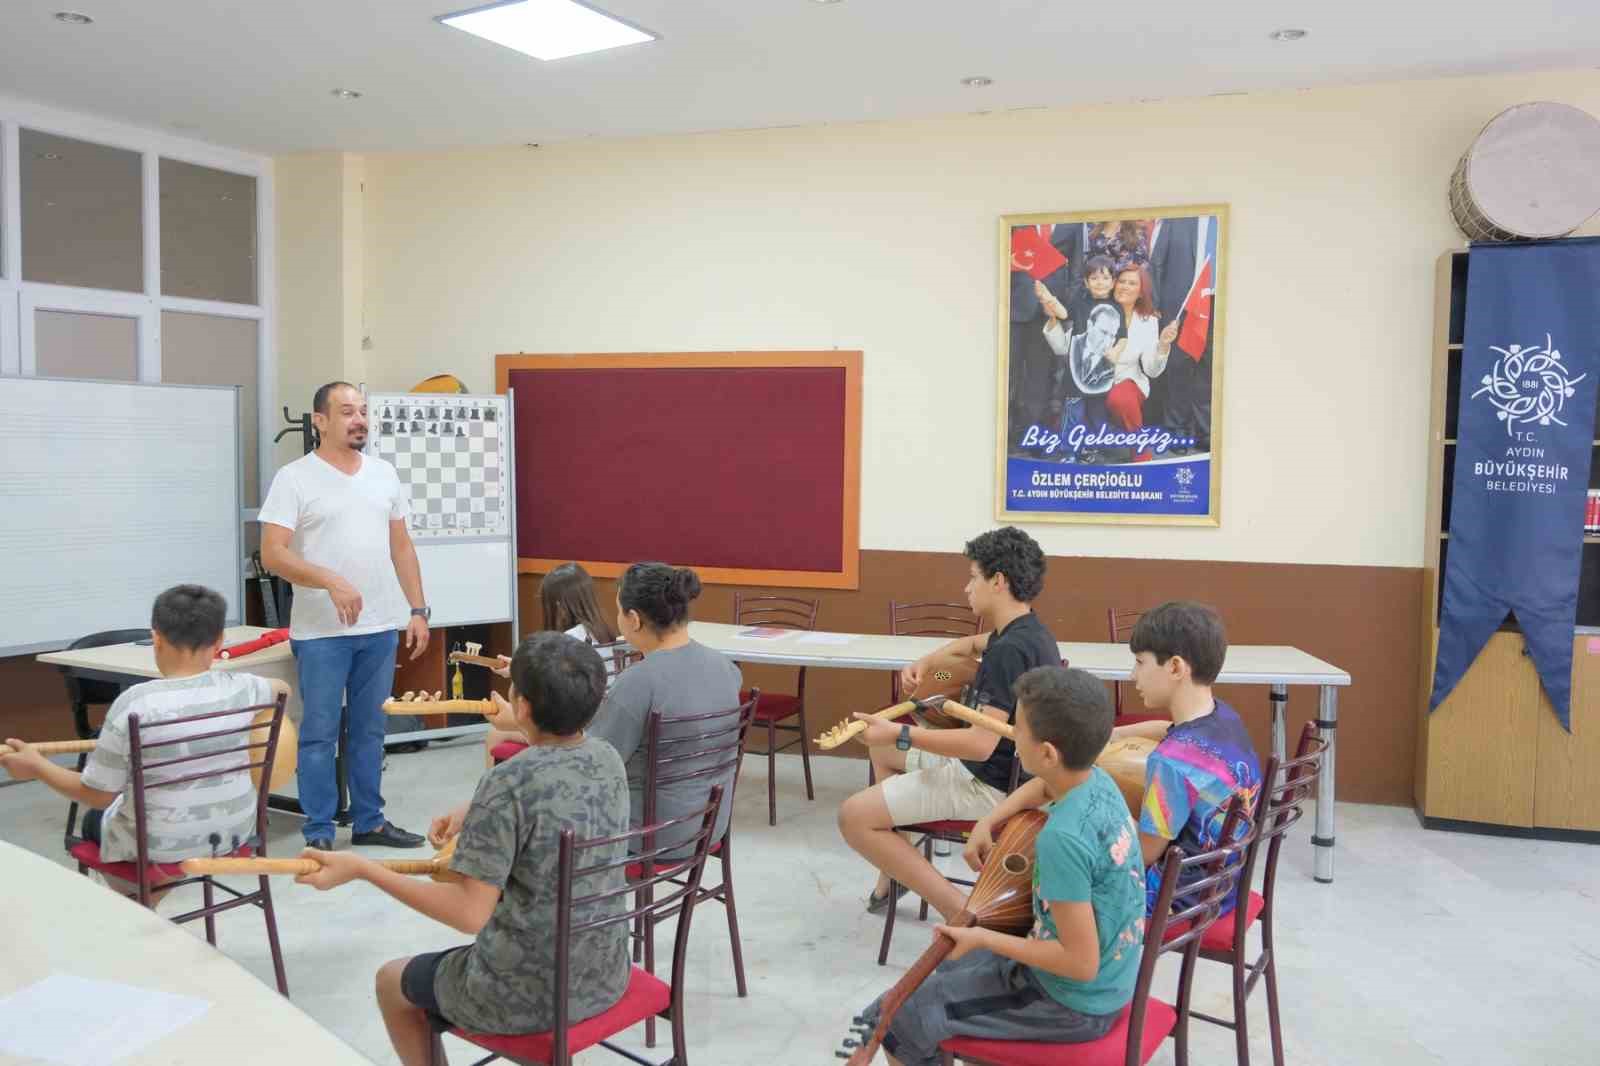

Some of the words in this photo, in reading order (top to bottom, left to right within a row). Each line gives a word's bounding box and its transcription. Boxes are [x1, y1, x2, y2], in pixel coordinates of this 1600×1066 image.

[1522, 380, 1539, 389] 1881
[1022, 425, 1061, 453] Biz
[1067, 424, 1195, 453] Geleceğiz...
[1506, 447, 1545, 458] AYDIN
[1474, 460, 1569, 481] BÜYÜKŞEHİR
[1031, 470, 1071, 487] ÖZLEM
[1074, 471, 1142, 490] ÇERÇİOĞLU
[1487, 480, 1556, 494] BELEDİYESİ
[1012, 489, 1025, 498] T.C.
[1027, 489, 1048, 498] AYDIN
[1049, 489, 1094, 500] BÜYÜKŞEHİR
[1095, 489, 1130, 500] BELEDİYE
[1131, 490, 1163, 502] BAŞKANI
